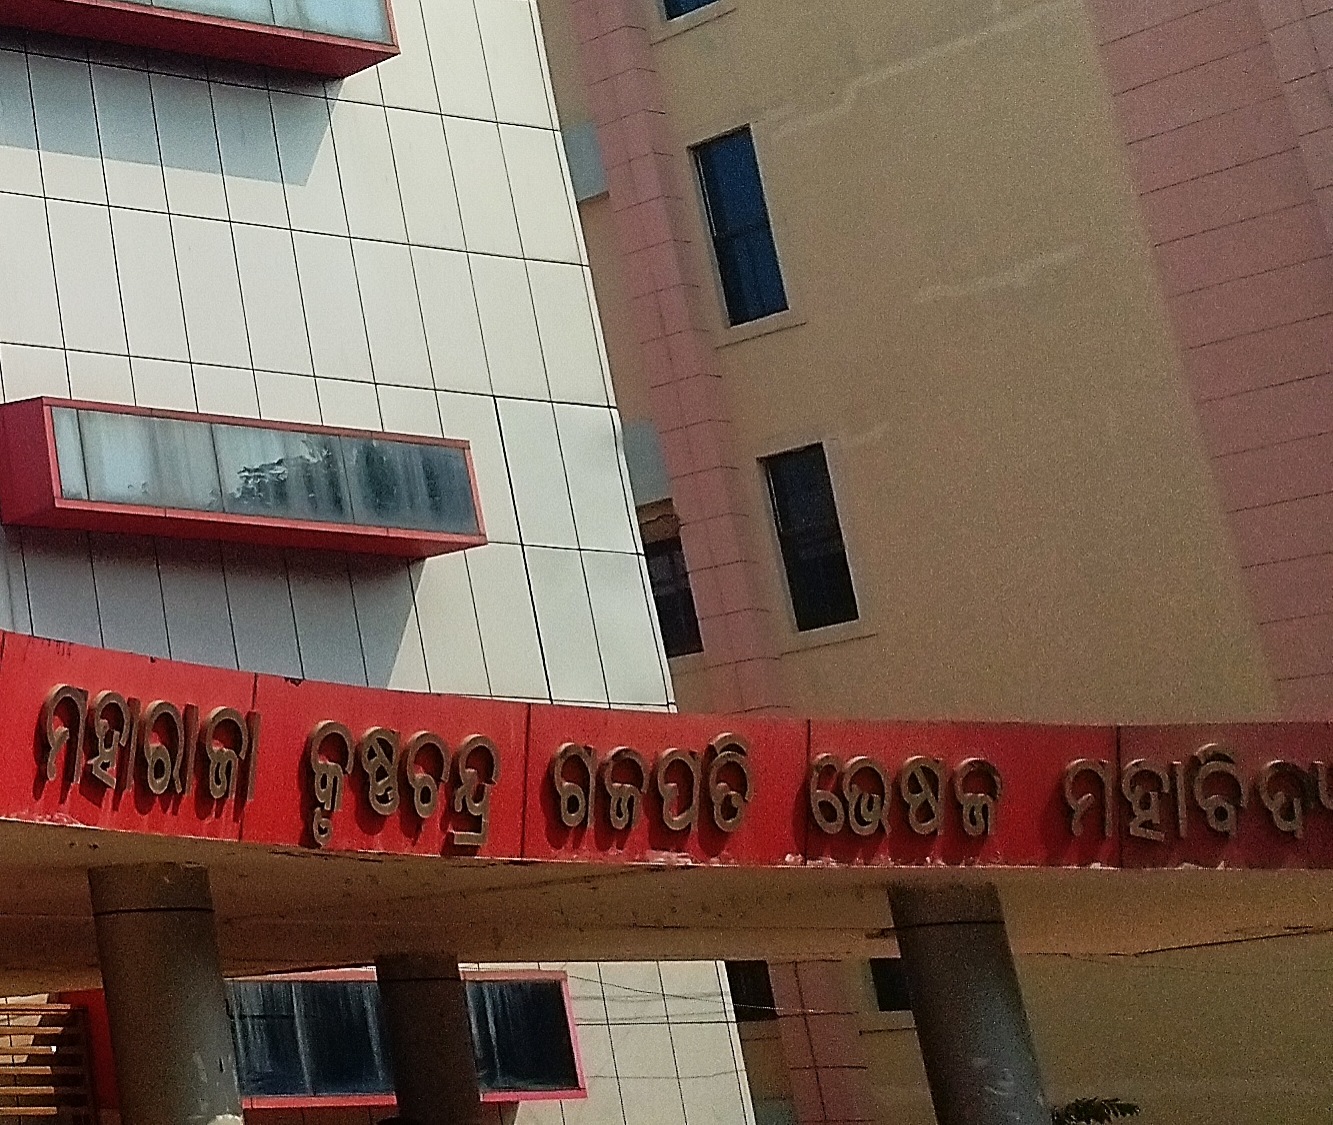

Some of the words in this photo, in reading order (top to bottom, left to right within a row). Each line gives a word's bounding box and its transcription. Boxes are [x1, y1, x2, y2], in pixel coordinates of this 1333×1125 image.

[46, 682, 262, 802] ମହାରାଜା
[553, 731, 755, 834] ଗଜପତି
[809, 752, 1003, 837] ଭେଷଜ
